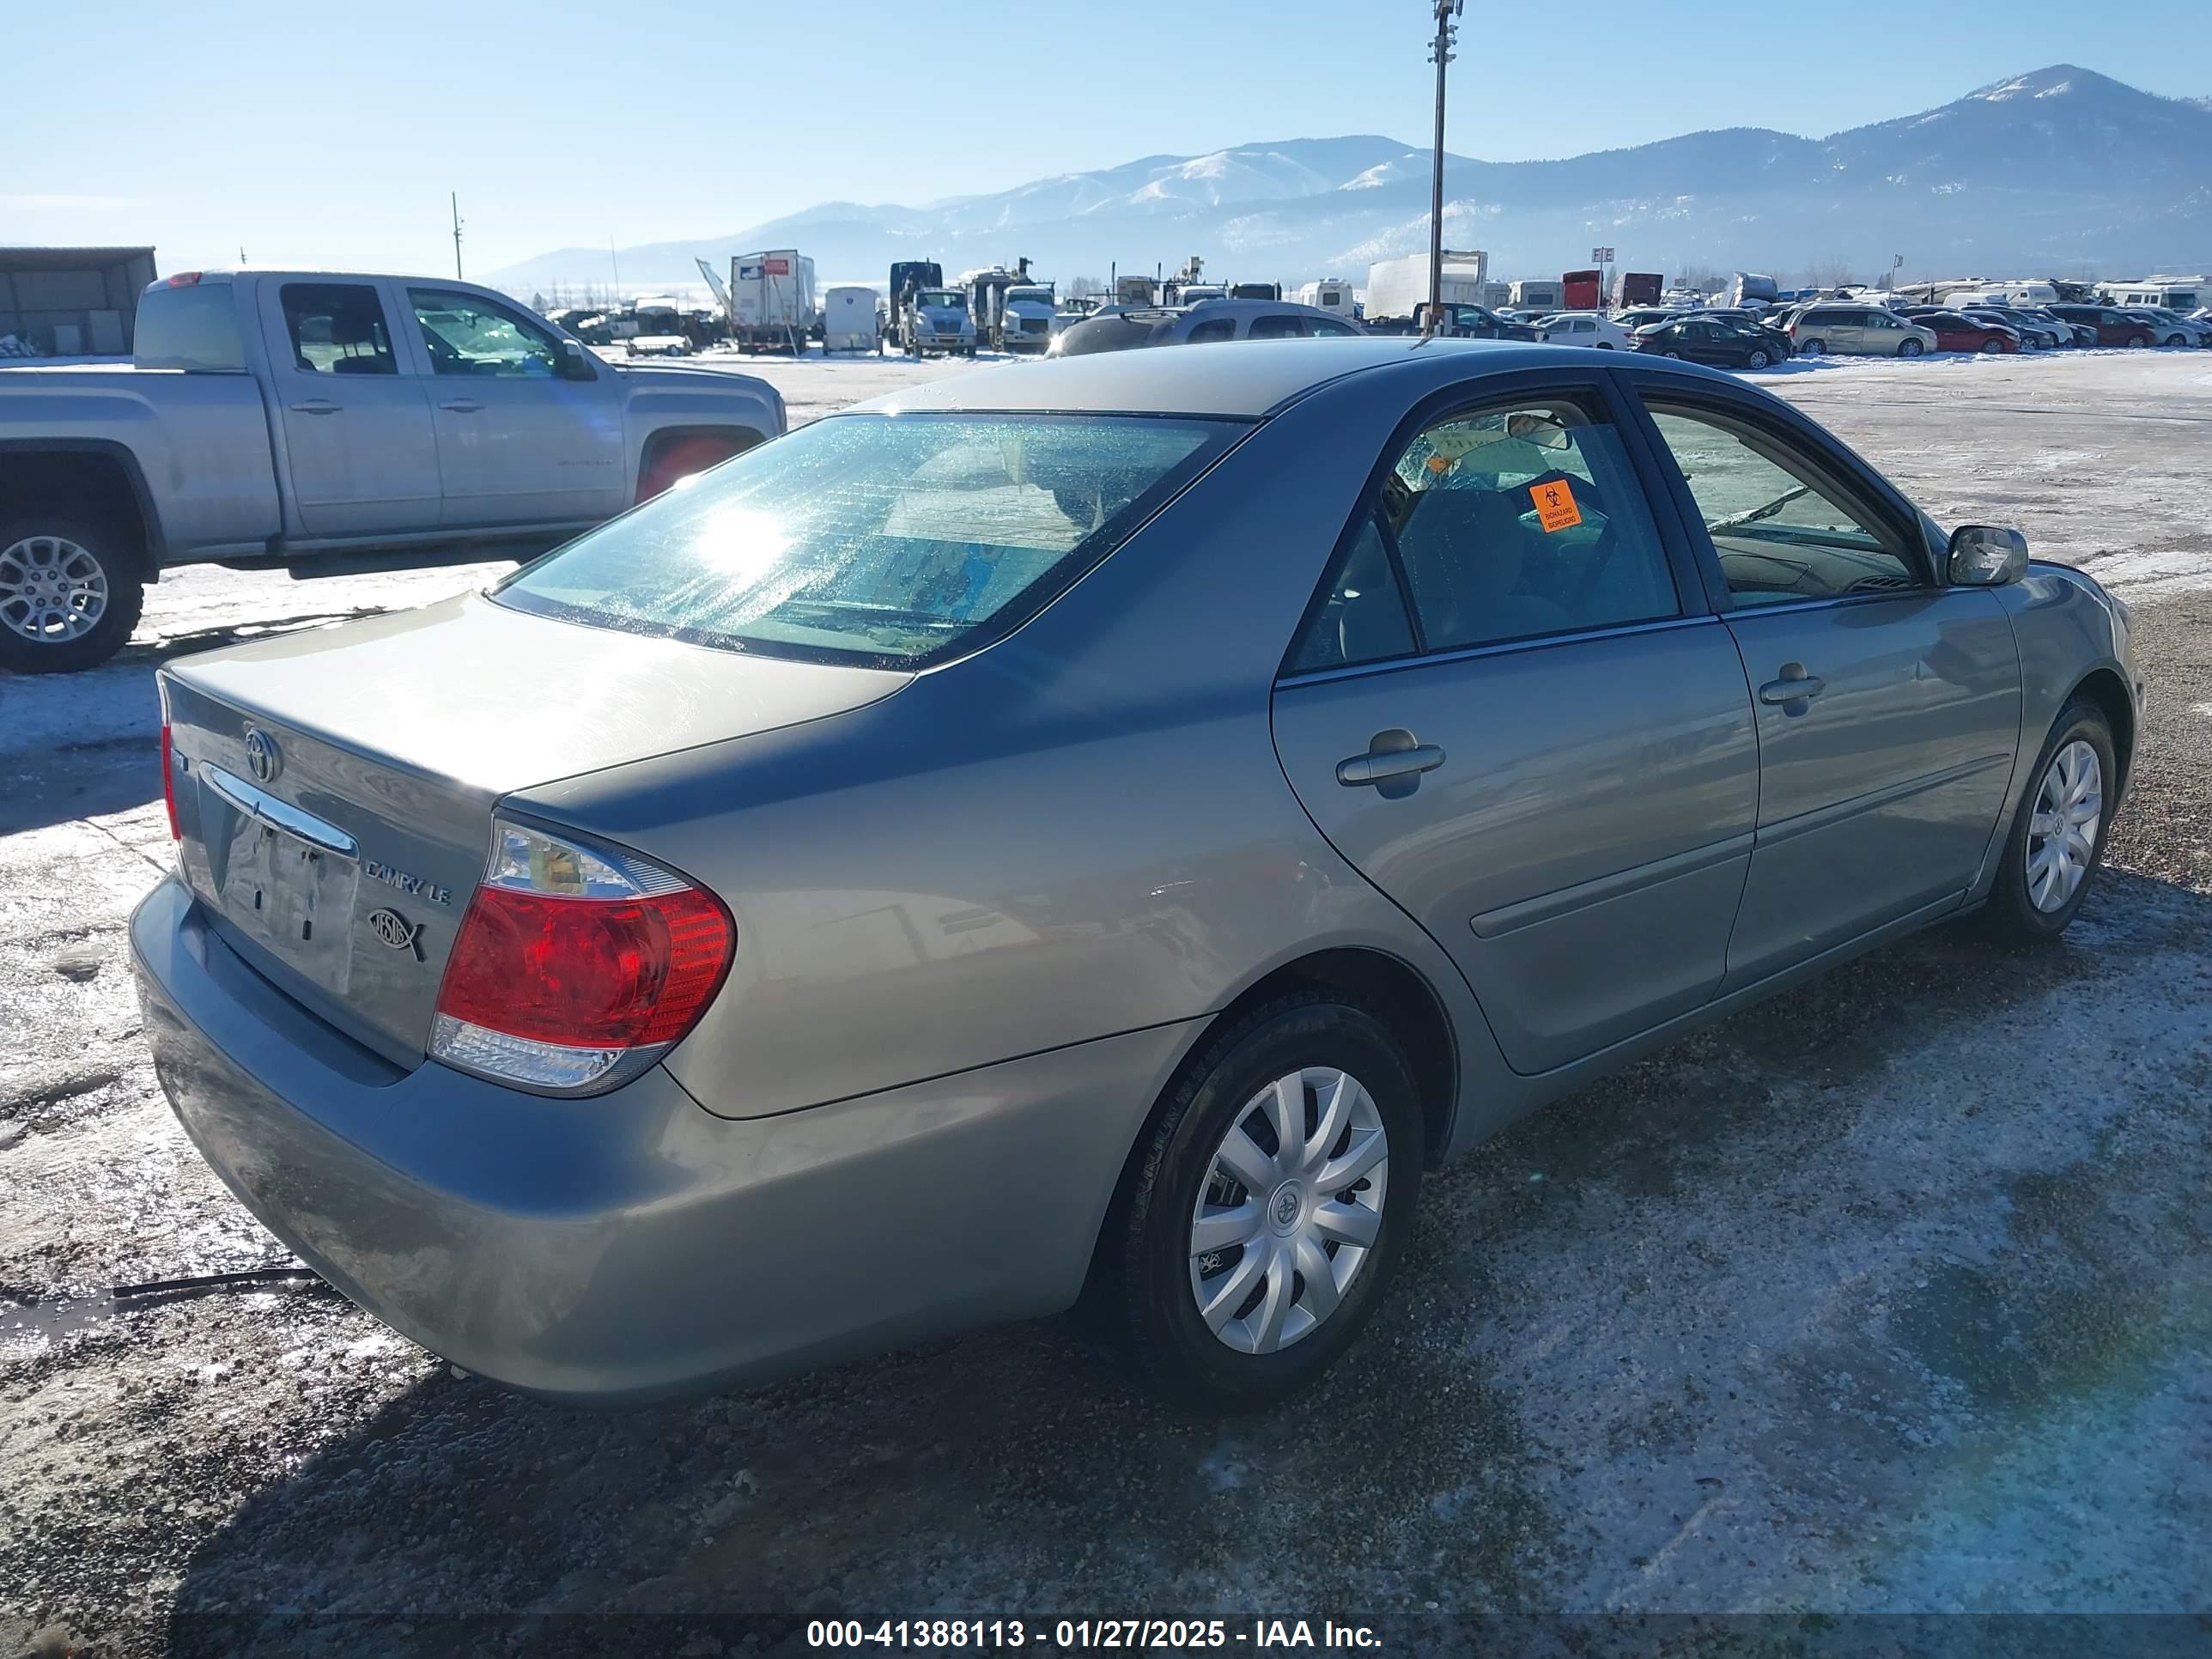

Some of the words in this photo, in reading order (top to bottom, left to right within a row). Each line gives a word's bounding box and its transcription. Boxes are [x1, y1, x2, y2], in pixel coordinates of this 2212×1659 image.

[1545, 507, 1573, 520] BIOHAZARD
[1548, 515, 1577, 529] BIOPELIGRO
[366, 861, 426, 895] CAMRY
[428, 885, 452, 906] LE
[372, 914, 405, 944] JESUS
